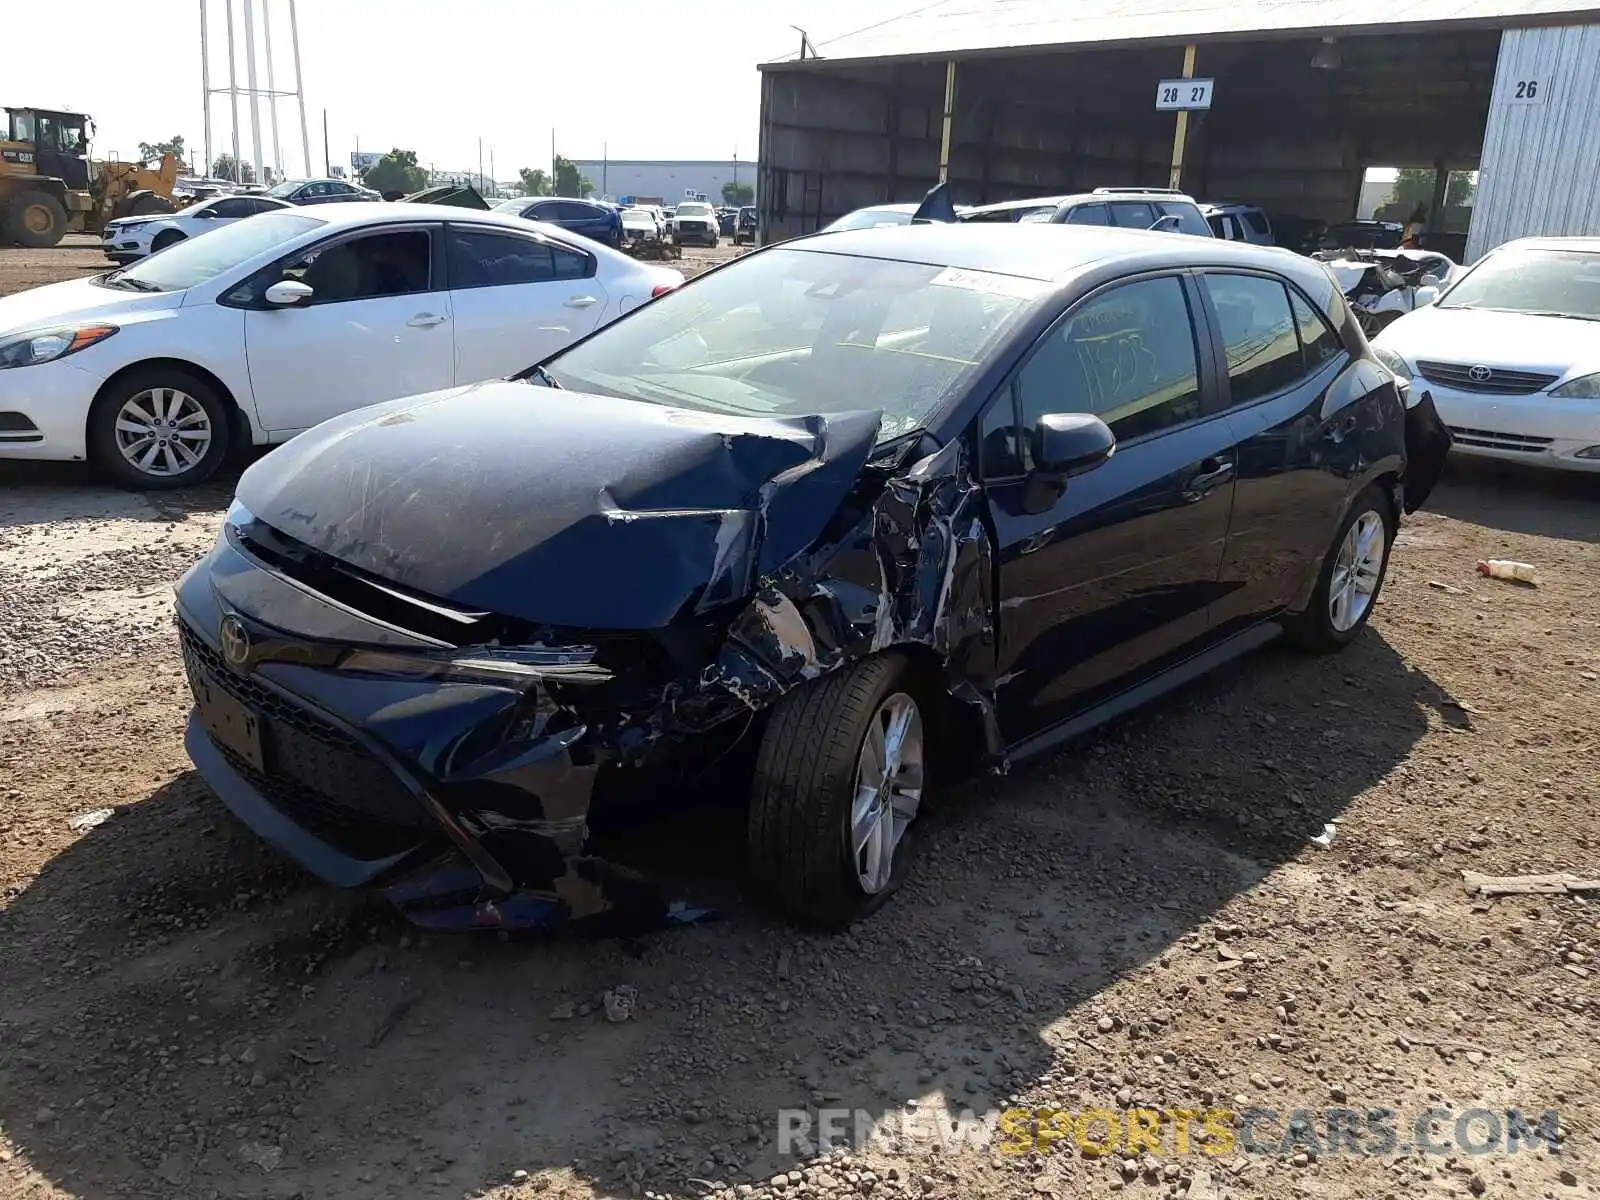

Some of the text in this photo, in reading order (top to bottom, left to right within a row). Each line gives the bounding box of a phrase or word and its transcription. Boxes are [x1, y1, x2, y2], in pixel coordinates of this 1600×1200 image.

[1163, 87, 1205, 103] 28 27
[1515, 80, 1538, 99] 26
